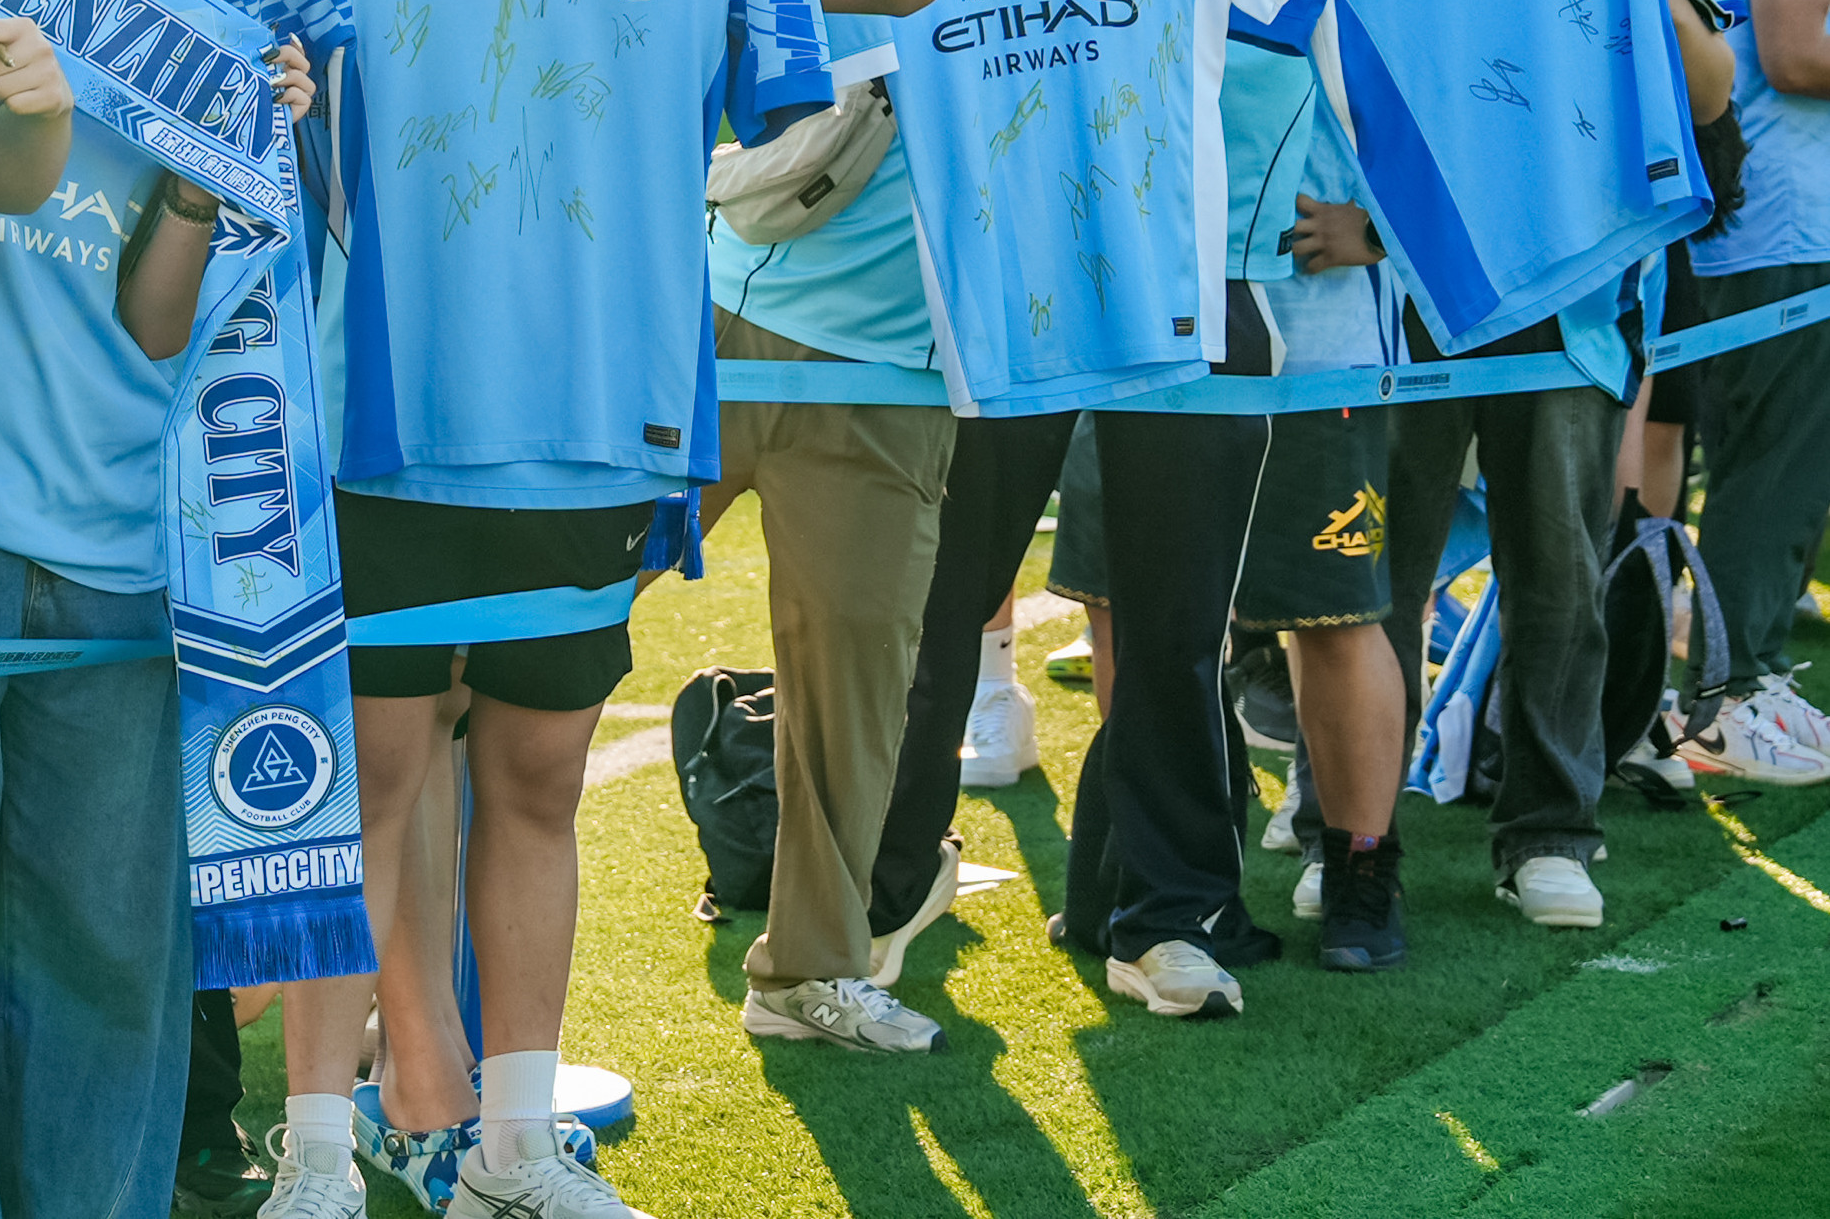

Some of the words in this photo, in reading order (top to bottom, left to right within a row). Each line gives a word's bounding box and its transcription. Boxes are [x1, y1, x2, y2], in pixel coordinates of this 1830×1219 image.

[982, 40, 1100, 81] AIRWAYS
[197, 372, 300, 578] CITY
[222, 713, 269, 754] SHENZHEN
[271, 711, 300, 724] PENG
[300, 720, 321, 740] CITY
[240, 807, 288, 822] FOOTBALL
[290, 798, 312, 817] CLUB
[198, 842, 361, 905] PENGCITY
